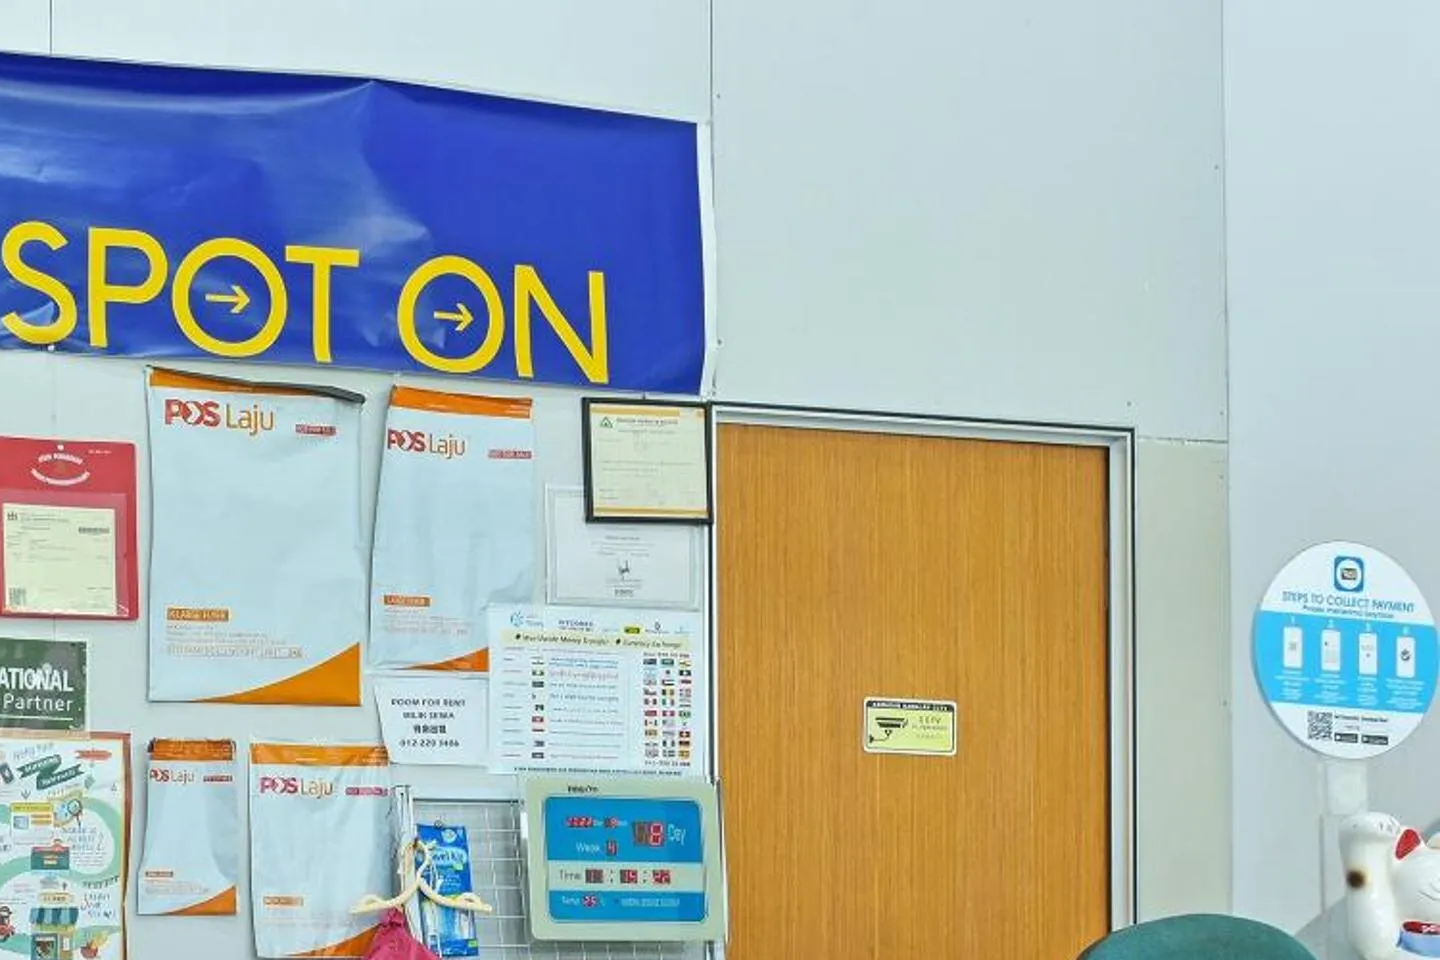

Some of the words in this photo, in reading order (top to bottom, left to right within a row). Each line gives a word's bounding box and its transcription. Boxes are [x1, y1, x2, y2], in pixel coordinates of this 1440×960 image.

[1, 221, 360, 363] SPOT
[397, 254, 609, 384] ON
[164, 398, 221, 427] POS
[226, 403, 274, 437] Laju
[387, 428, 427, 452] POS
[429, 433, 465, 459] Laju
[3, 692, 73, 711] Partner
[260, 777, 298, 796] POS
[300, 778, 333, 799] Laju
